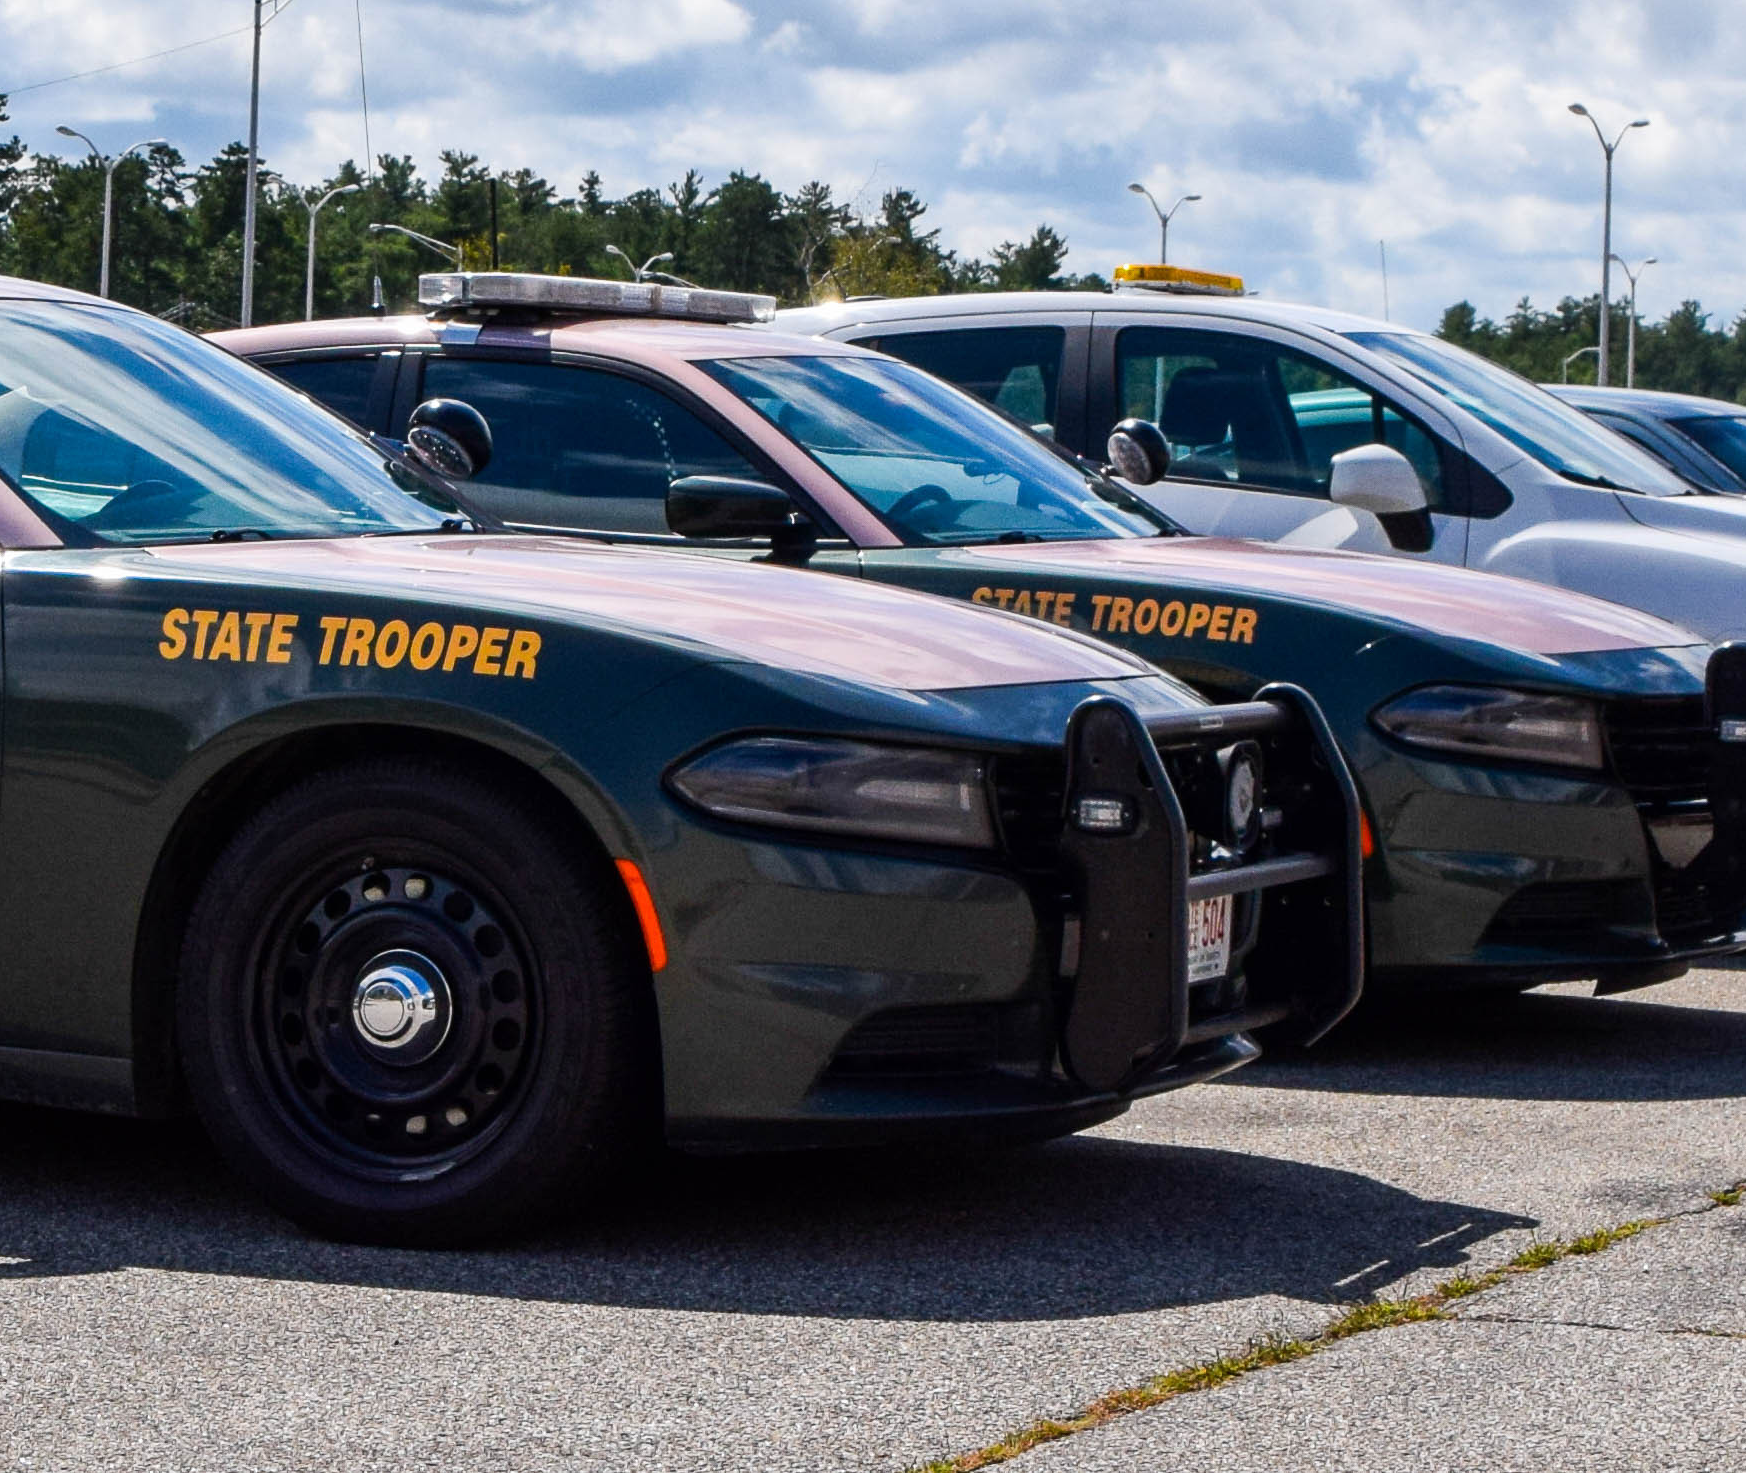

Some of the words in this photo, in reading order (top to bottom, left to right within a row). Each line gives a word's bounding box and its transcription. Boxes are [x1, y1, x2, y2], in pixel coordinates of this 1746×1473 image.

[159, 608, 299, 663] STATE
[319, 617, 542, 679] TROOPER
[1091, 595, 1258, 644] TROOPER
[1202, 897, 1226, 947] 504
